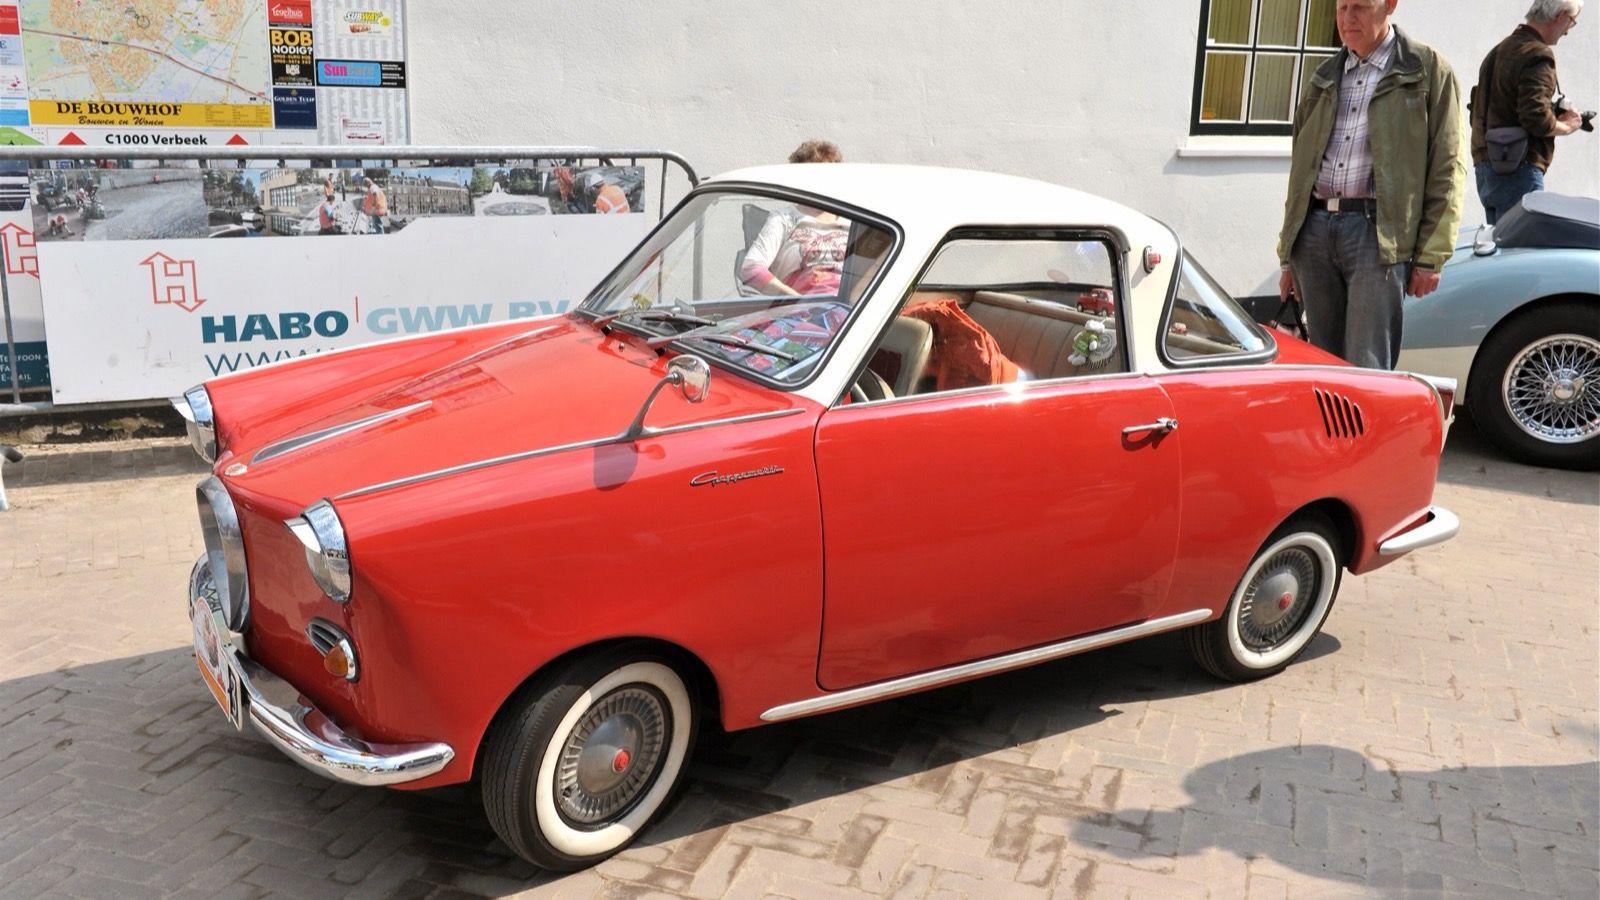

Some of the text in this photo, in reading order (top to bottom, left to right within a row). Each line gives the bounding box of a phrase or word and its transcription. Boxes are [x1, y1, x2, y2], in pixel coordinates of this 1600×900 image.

[344, 10, 384, 22] SUBWAY
[271, 30, 313, 46] BOB
[272, 45, 313, 55] NODIG?
[56, 102, 182, 116] DE BOUWHOF
[78, 115, 115, 125] Bouwen
[133, 116, 164, 126] Wonen
[105, 133, 208, 146] C1000 Verbeek
[201, 310, 349, 343] HABO
[366, 303, 493, 335] GWW
